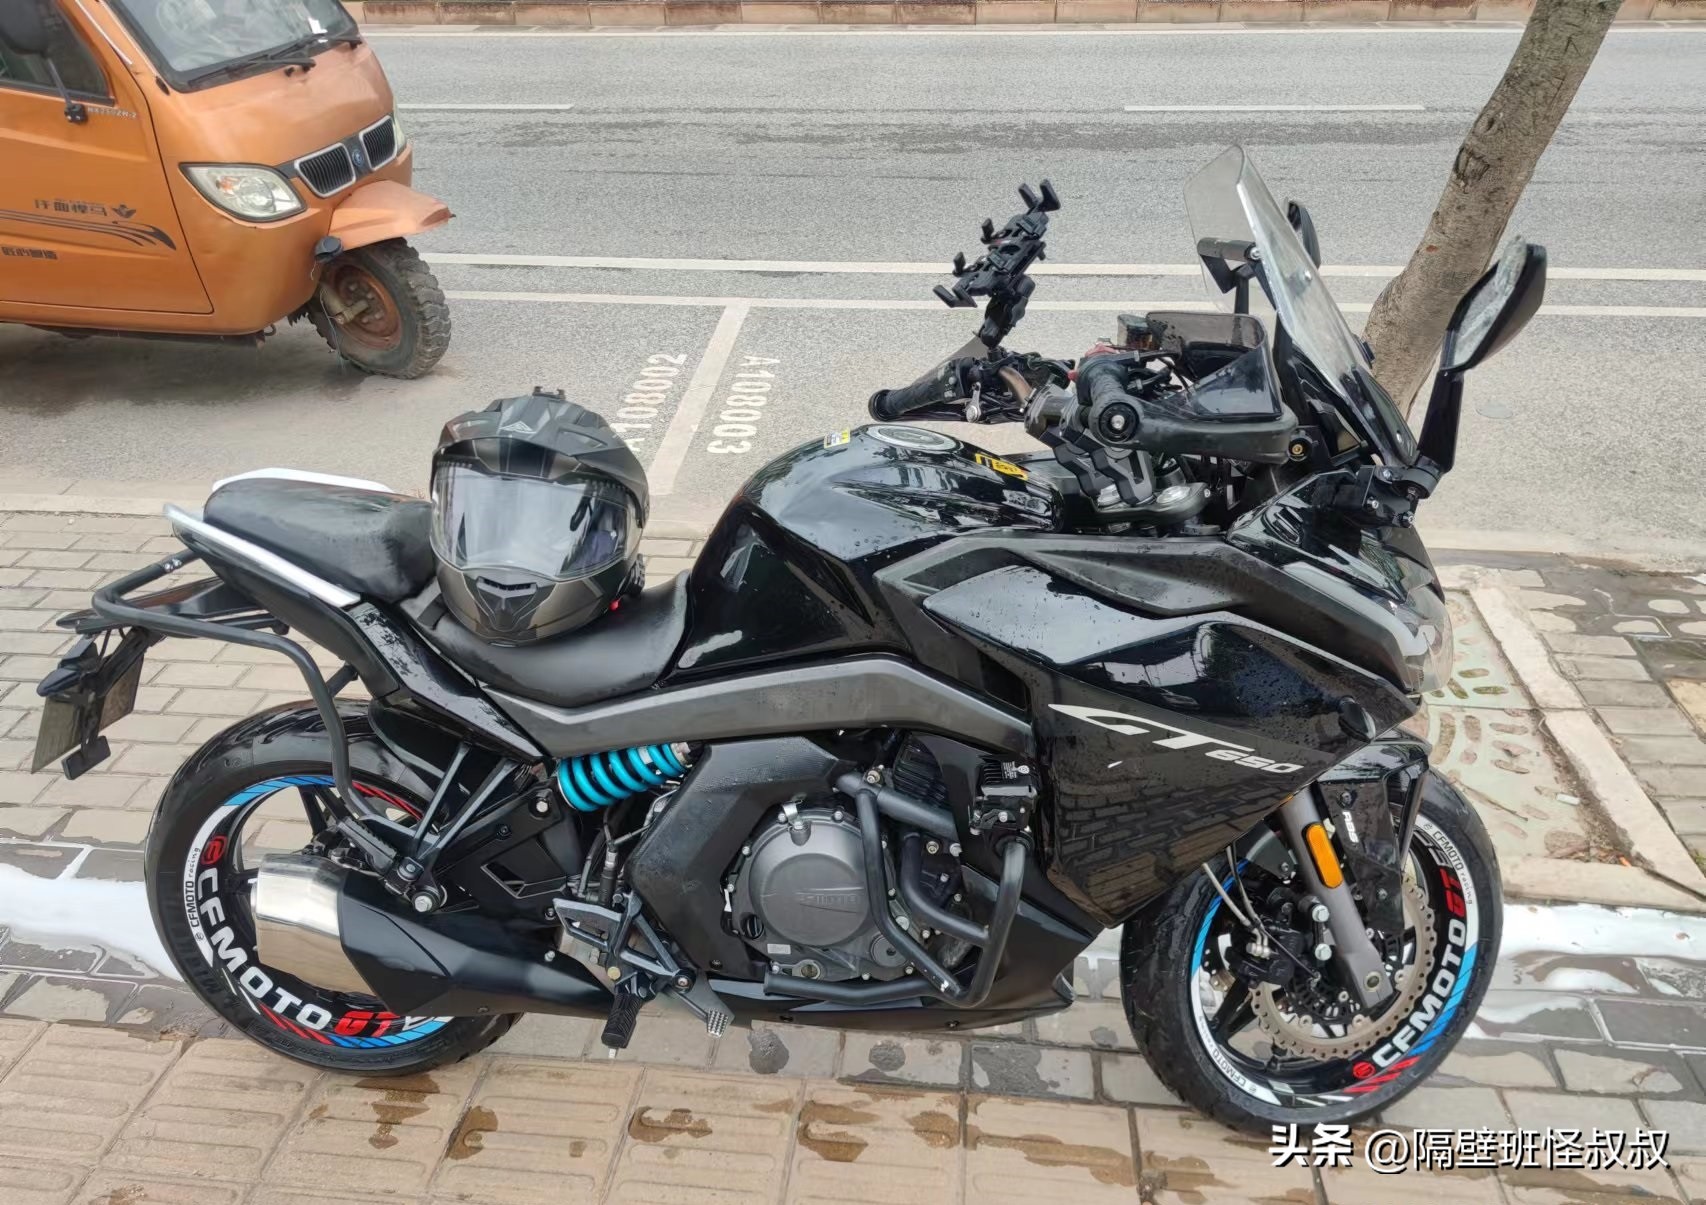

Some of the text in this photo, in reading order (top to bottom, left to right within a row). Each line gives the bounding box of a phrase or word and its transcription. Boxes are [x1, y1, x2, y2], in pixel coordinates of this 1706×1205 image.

[706, 355, 781, 454] A108003
[1204, 749, 1305, 774] 650
[1342, 811, 1360, 843] ABS
[1432, 830, 1465, 871] CFMOTO
[184, 847, 201, 928] CFMOTO racing
[197, 867, 333, 1031] CFMOTO
[1371, 918, 1467, 1068] CFMOTO
[1439, 867, 1466, 918] GT
